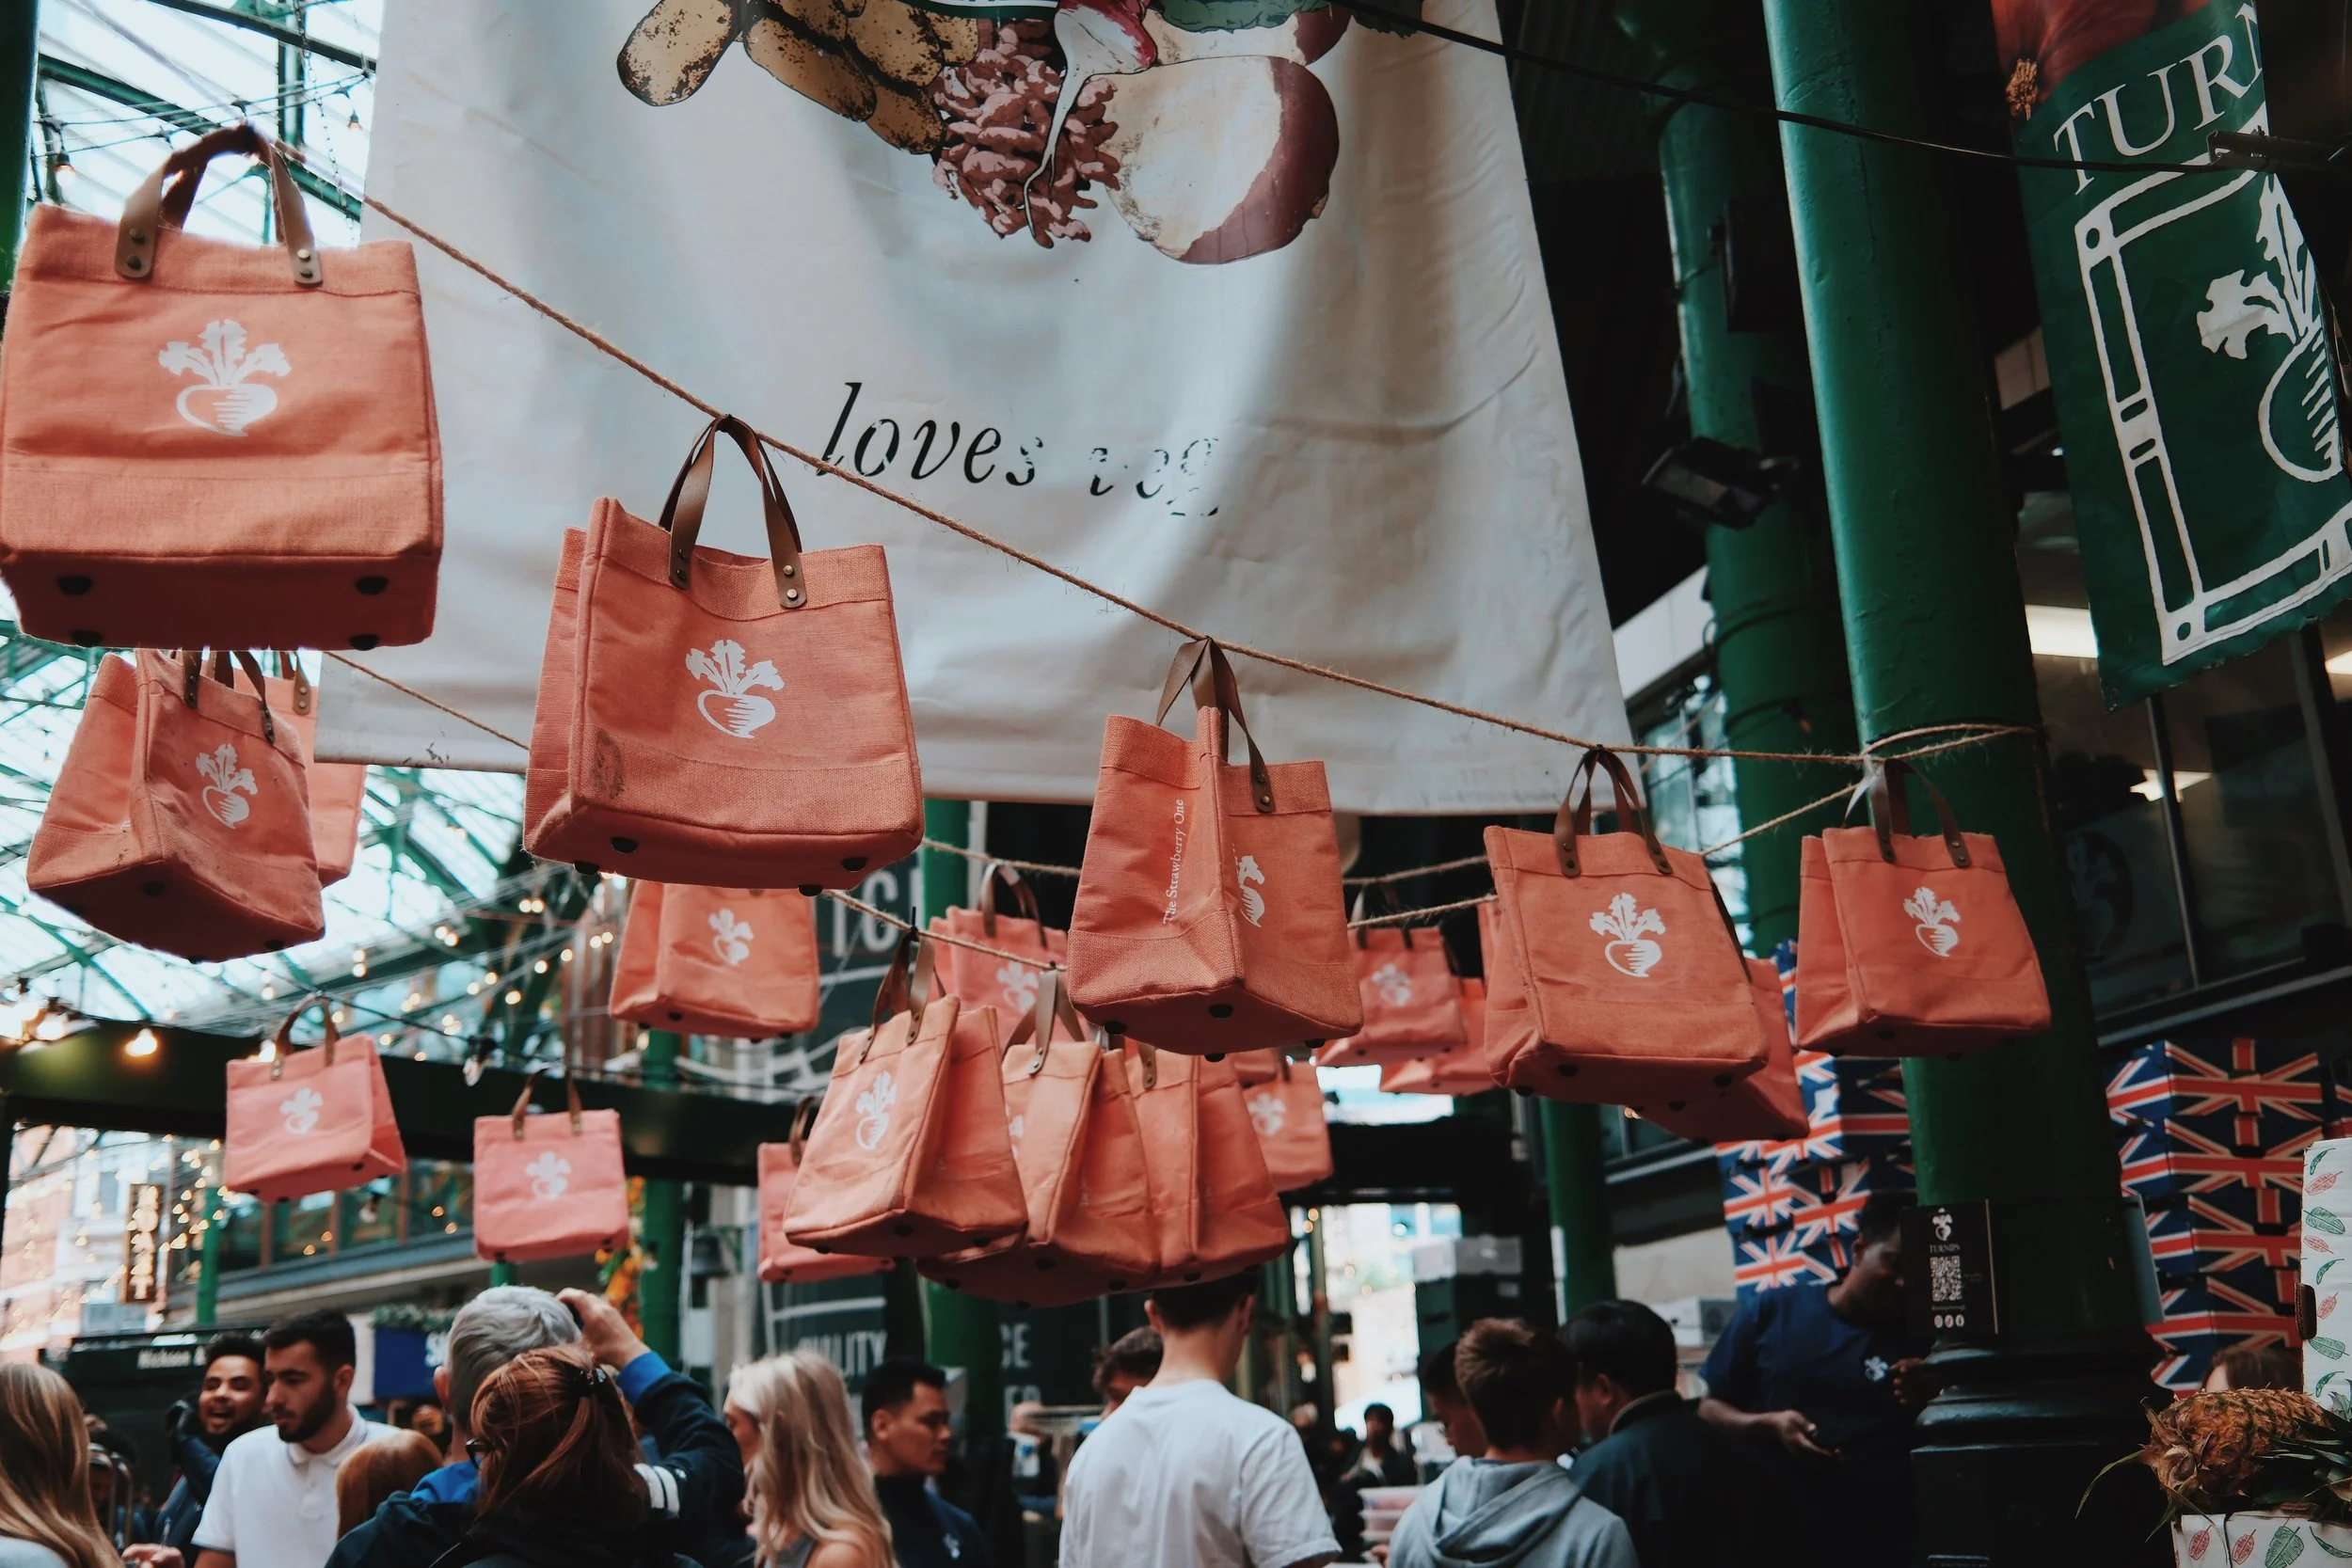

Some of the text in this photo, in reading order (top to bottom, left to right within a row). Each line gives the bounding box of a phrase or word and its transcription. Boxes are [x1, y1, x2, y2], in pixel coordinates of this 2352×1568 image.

[816, 382, 1043, 486] loves
[1162, 799, 1186, 925] The Strawberry One
[797, 1329, 887, 1377] ALITY
